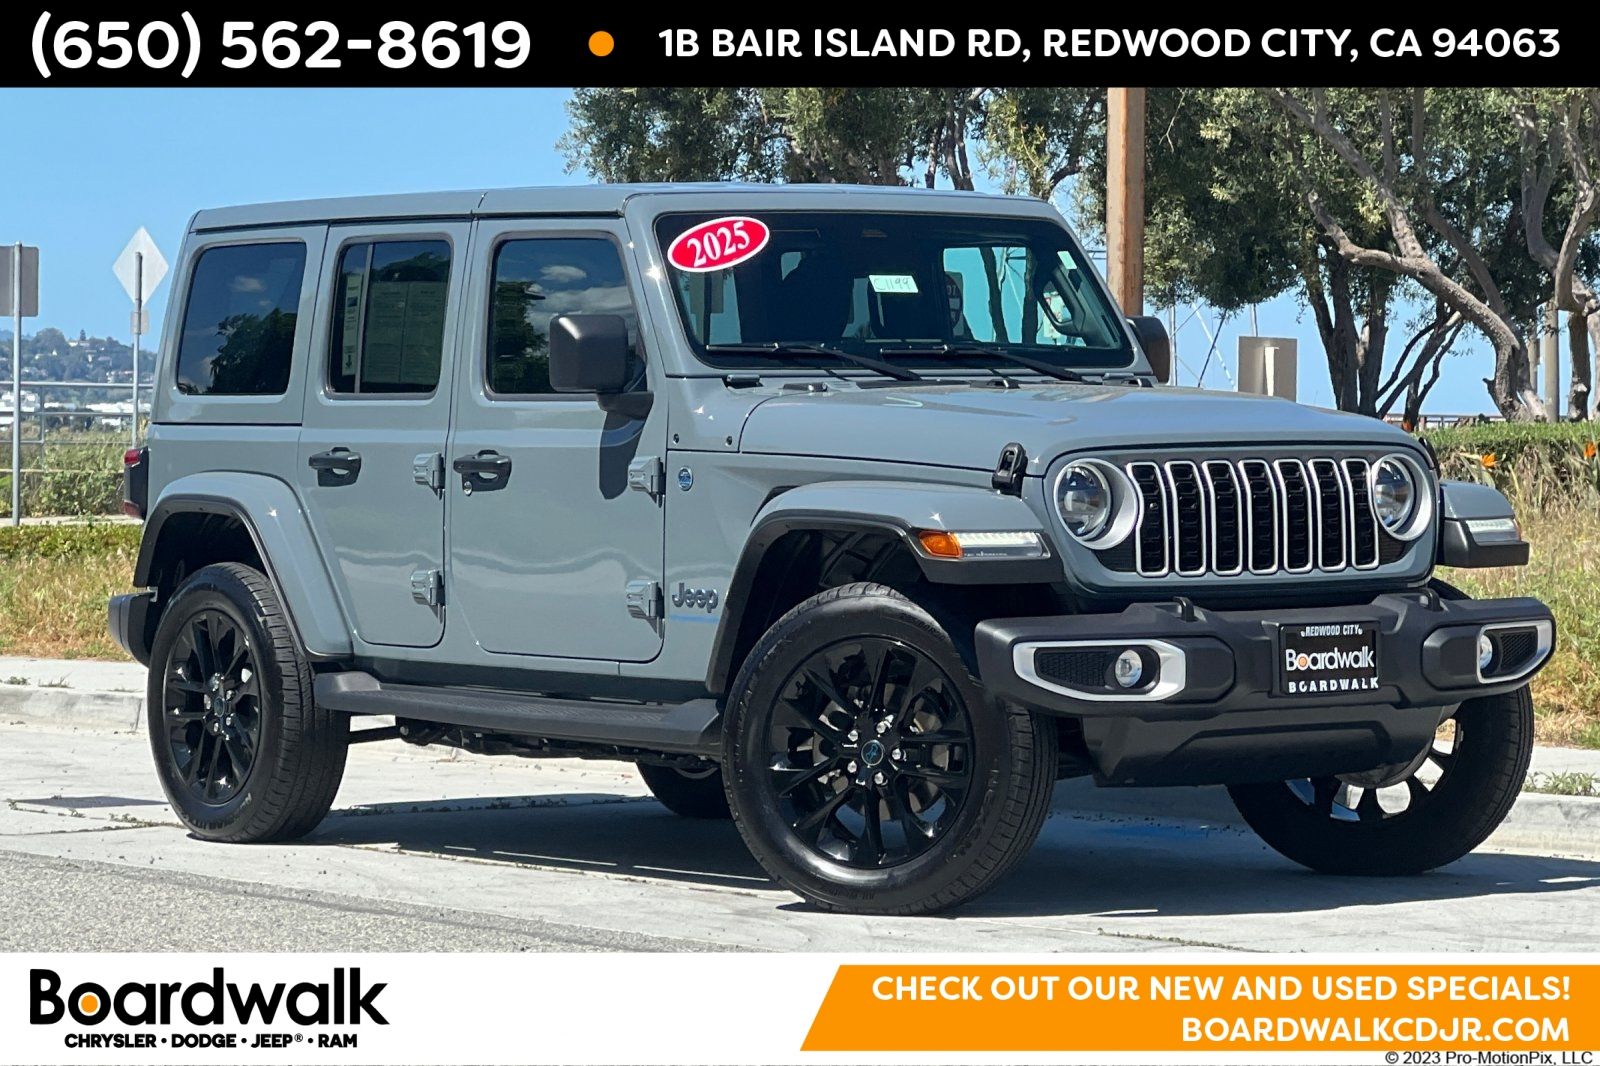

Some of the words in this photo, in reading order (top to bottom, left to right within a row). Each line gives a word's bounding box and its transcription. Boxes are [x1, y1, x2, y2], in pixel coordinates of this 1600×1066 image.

[686, 220, 750, 268] 2025
[672, 582, 719, 613] Jeep
[1305, 625, 1340, 637] REDWOOD
[1343, 624, 1359, 635] CITY
[1285, 645, 1375, 671] Boardwalk
[1288, 676, 1379, 693] BOARDWALK
